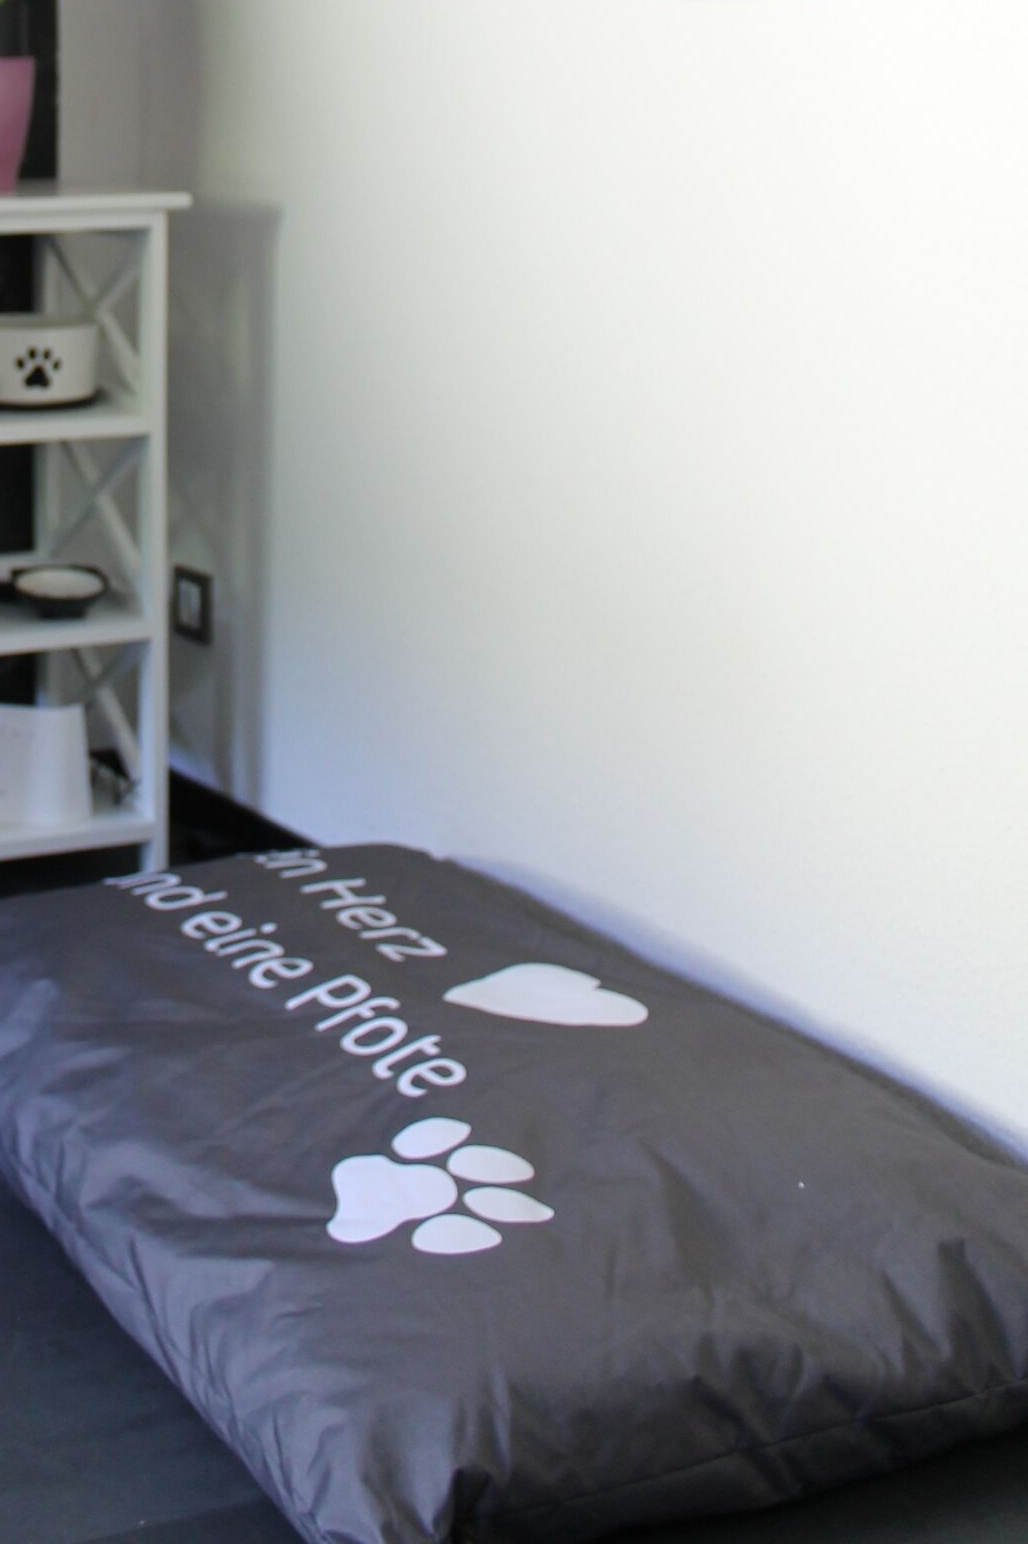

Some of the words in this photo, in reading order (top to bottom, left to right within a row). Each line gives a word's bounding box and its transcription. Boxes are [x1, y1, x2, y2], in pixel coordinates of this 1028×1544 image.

[102, 871, 228, 911] nd
[180, 910, 314, 989] eine
[284, 974, 467, 1098] Pfote
[299, 878, 448, 962] Herz
